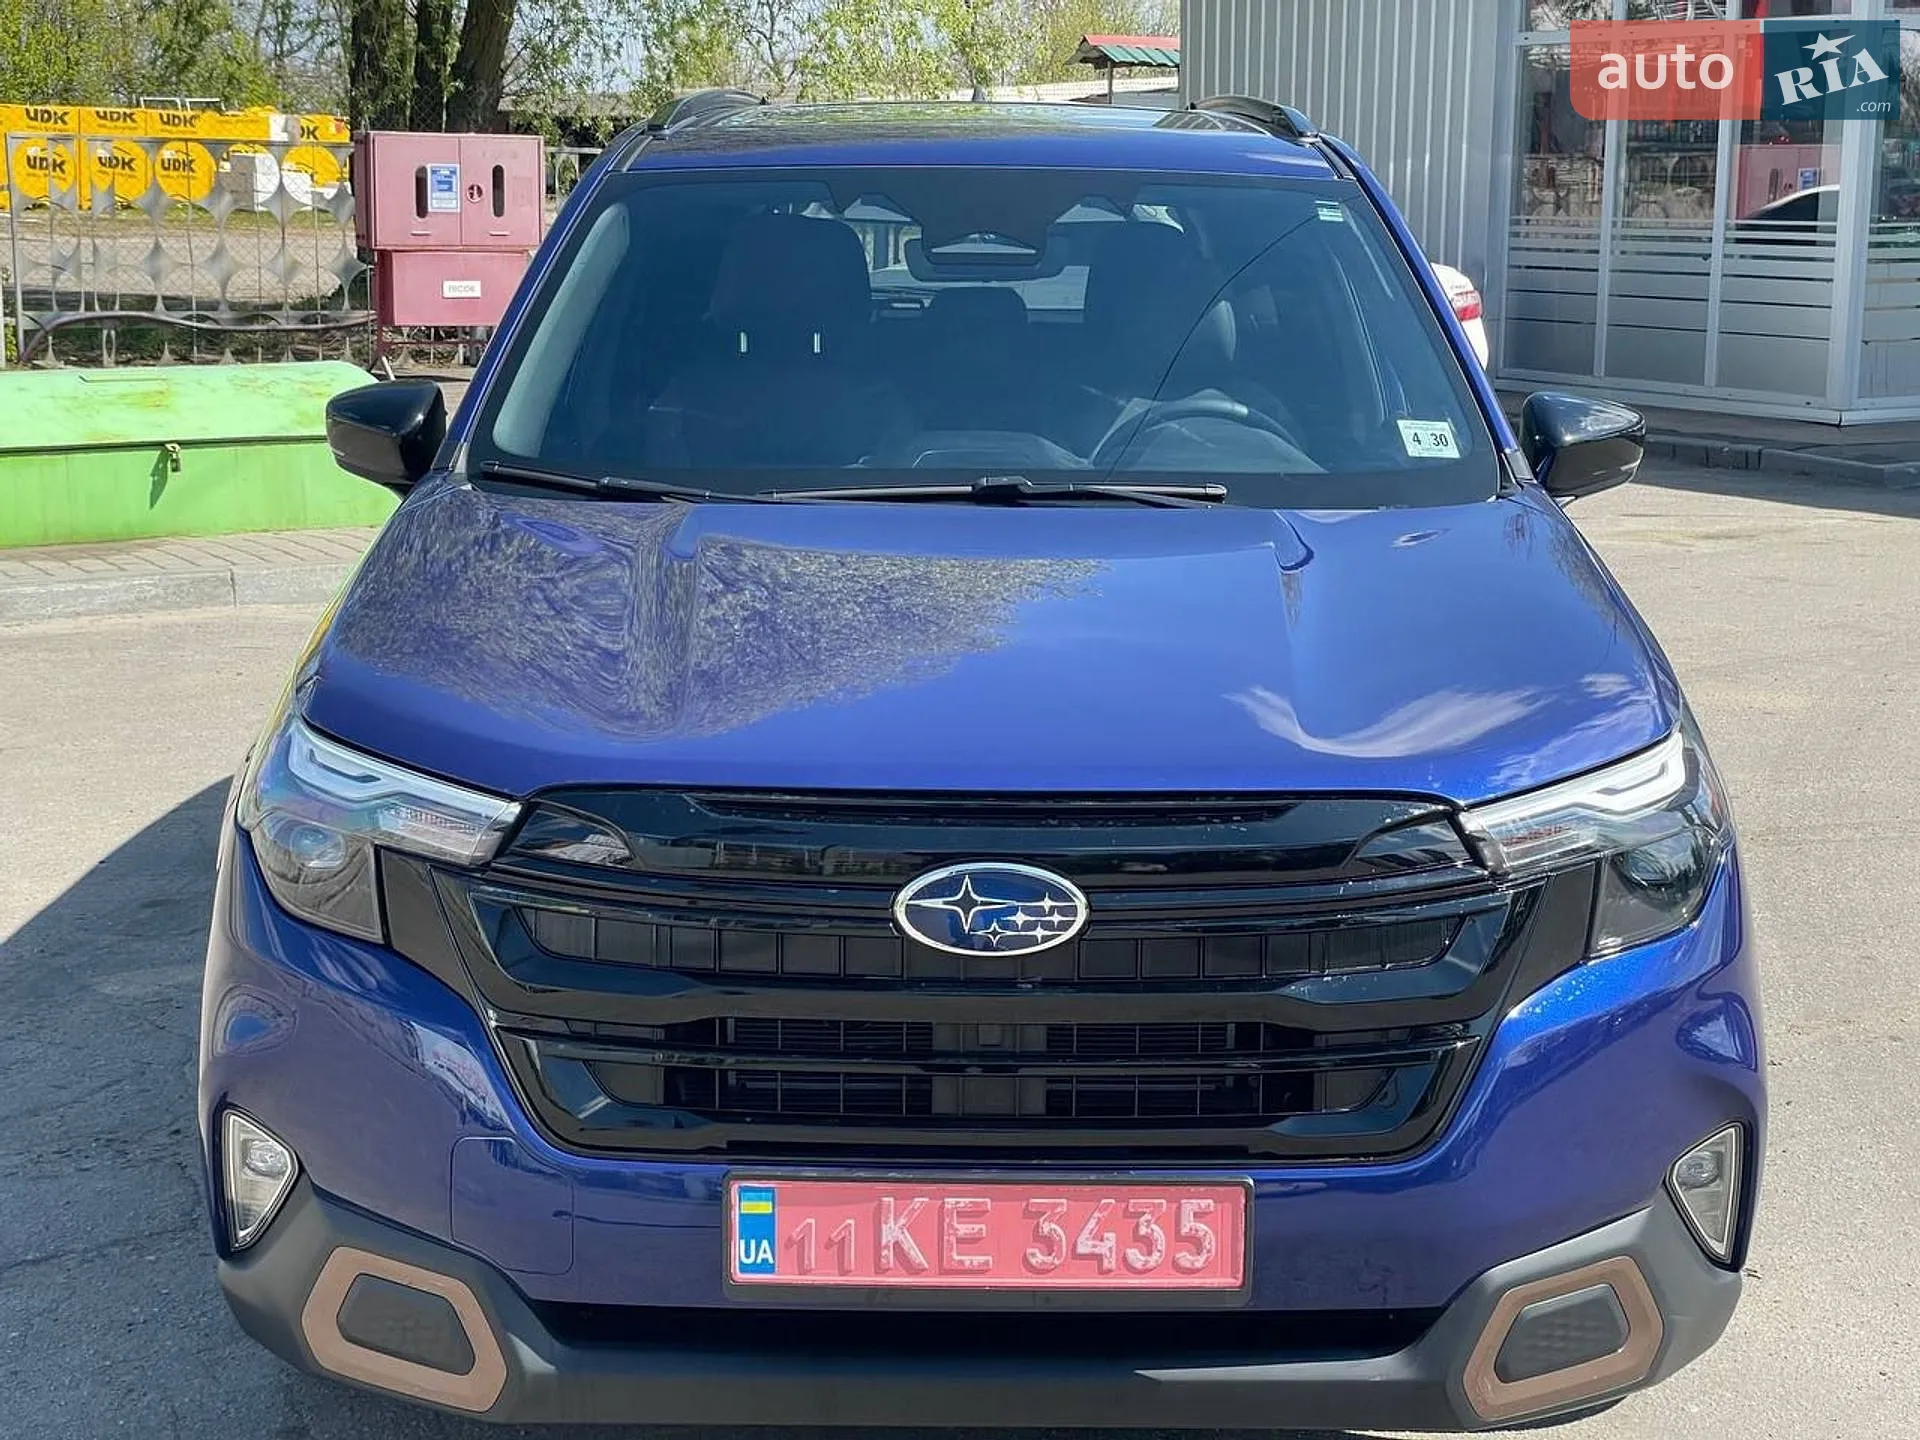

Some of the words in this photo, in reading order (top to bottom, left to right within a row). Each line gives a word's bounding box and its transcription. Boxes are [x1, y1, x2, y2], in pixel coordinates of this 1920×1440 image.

[24, 107, 70, 126] UDK
[95, 110, 137, 123] UDK
[1412, 431, 1422, 446] 4
[1430, 432, 1449, 447] 30
[1023, 1196, 1217, 1273] 3435
[738, 1239, 775, 1264] UA
